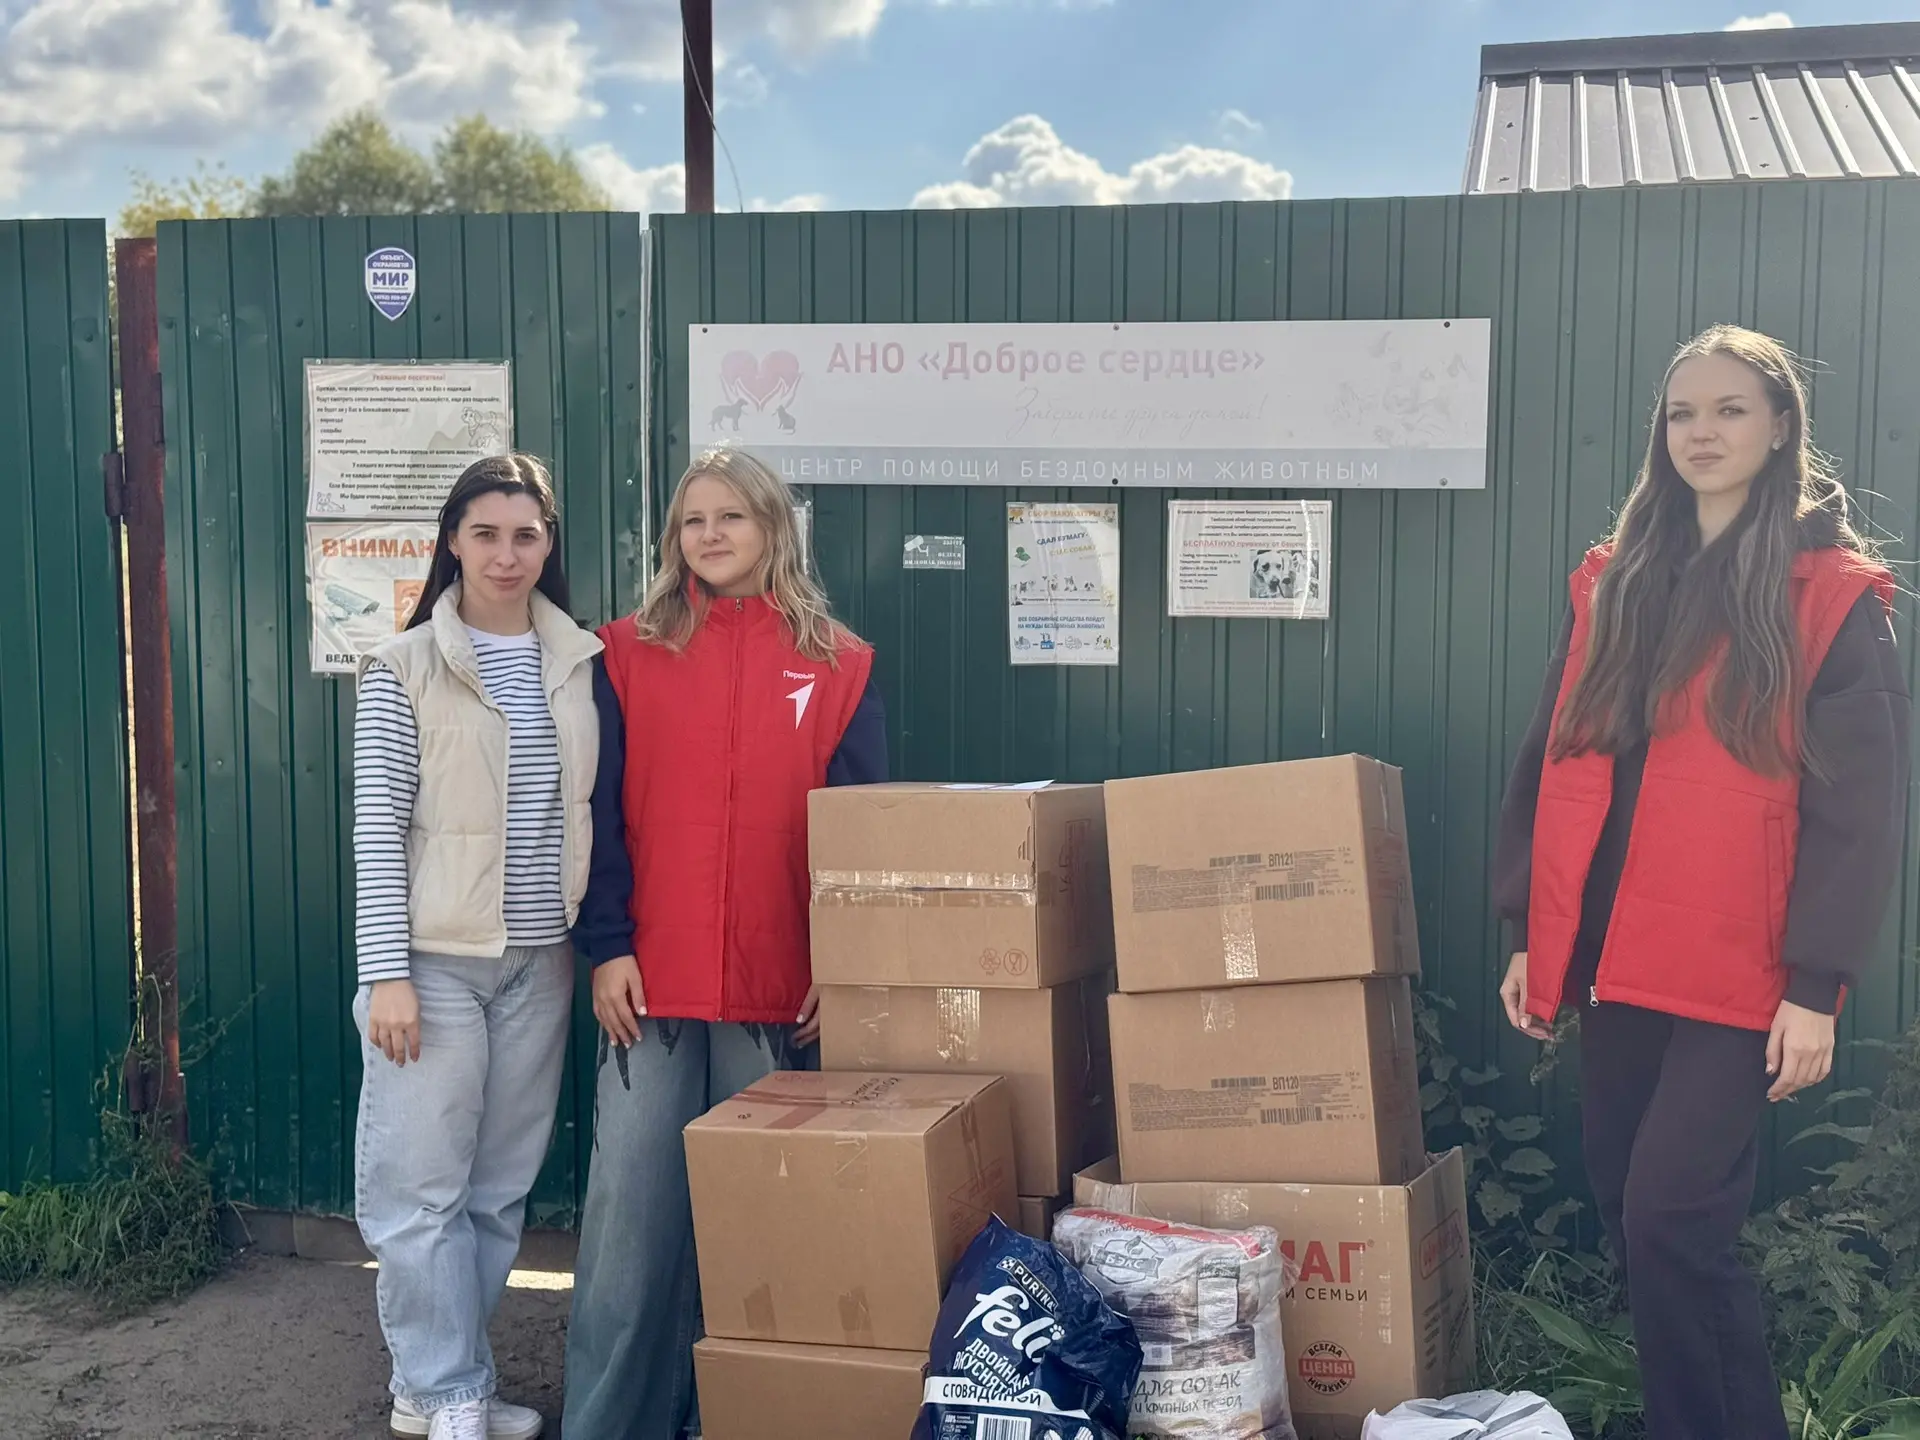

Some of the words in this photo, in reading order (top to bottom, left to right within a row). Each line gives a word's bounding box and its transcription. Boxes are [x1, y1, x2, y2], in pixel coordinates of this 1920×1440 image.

[373, 272, 409, 286] МИР
[826, 342, 904, 374] АНО
[918, 341, 1086, 381] «Доброе
[1100, 348, 1265, 382] сердце»
[782, 457, 862, 478] ЦЕНТР
[883, 459, 998, 480] ПОМОЩИ
[1020, 460, 1192, 482] БЕЗДОМНЫМ
[1214, 461, 1378, 480] ЖИВОТНЫМ
[1037, 536, 1056, 545] СДАЛ
[322, 538, 435, 558] ВНИМАН
[326, 654, 359, 664] ВЕДЕ
[783, 670, 815, 680] Первые
[1268, 853, 1294, 867] ВП121
[1273, 1076, 1299, 1090] ВП120
[1106, 1254, 1144, 1268] БЭКС
[1014, 1266, 1054, 1312] PURINA
[1305, 1288, 1368, 1301] СЕМЬИ
[953, 1285, 1055, 1364] feli
[1308, 1344, 1342, 1357] ВСЕГДА
[966, 1338, 1020, 1384] ДВОЙНА
[1303, 1361, 1352, 1375] ЦЕНЫ!
[1134, 1379, 1174, 1402] ДЛЯ
[1308, 1377, 1347, 1392] НИЗКИЕ
[1146, 1400, 1199, 1414] КРУПНЫХ
[1203, 1395, 1242, 1410] ПОД
